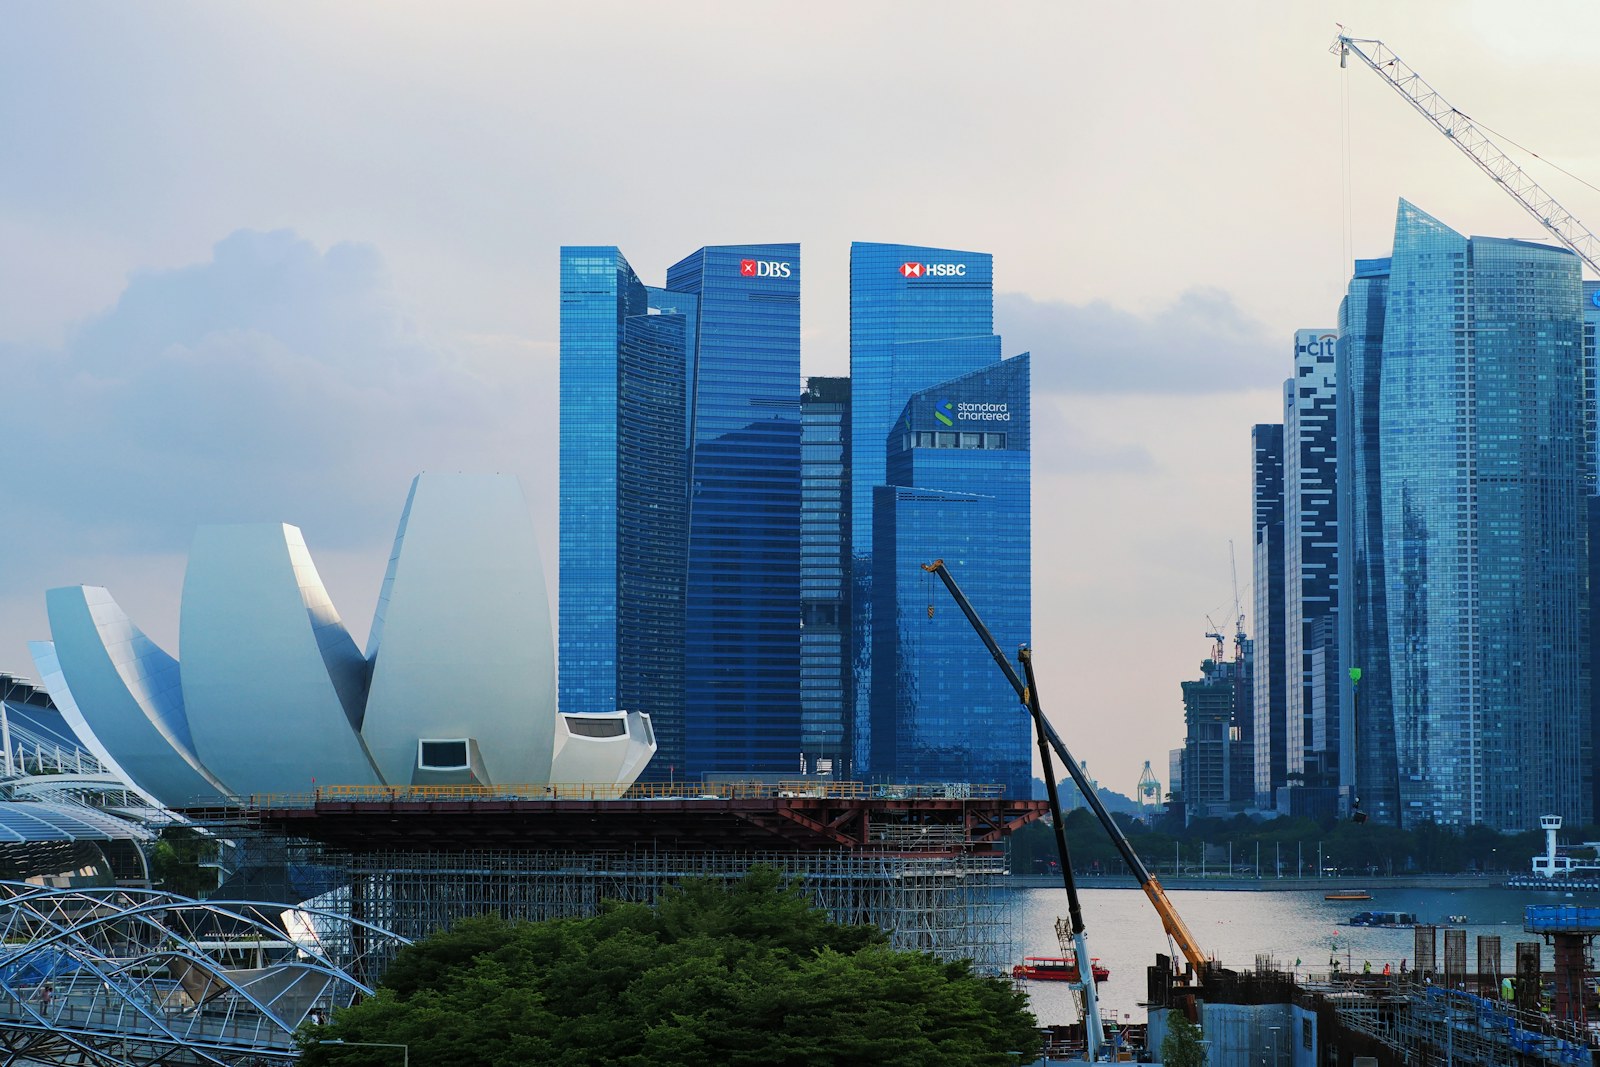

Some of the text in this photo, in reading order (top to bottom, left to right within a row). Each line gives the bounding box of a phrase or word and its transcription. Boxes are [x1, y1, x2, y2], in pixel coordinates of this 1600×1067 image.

[757, 261, 791, 278] DBS
[926, 264, 966, 276] HSBC
[1307, 337, 1335, 356] cit
[957, 402, 1007, 412] standard
[957, 411, 1010, 421] chartered
